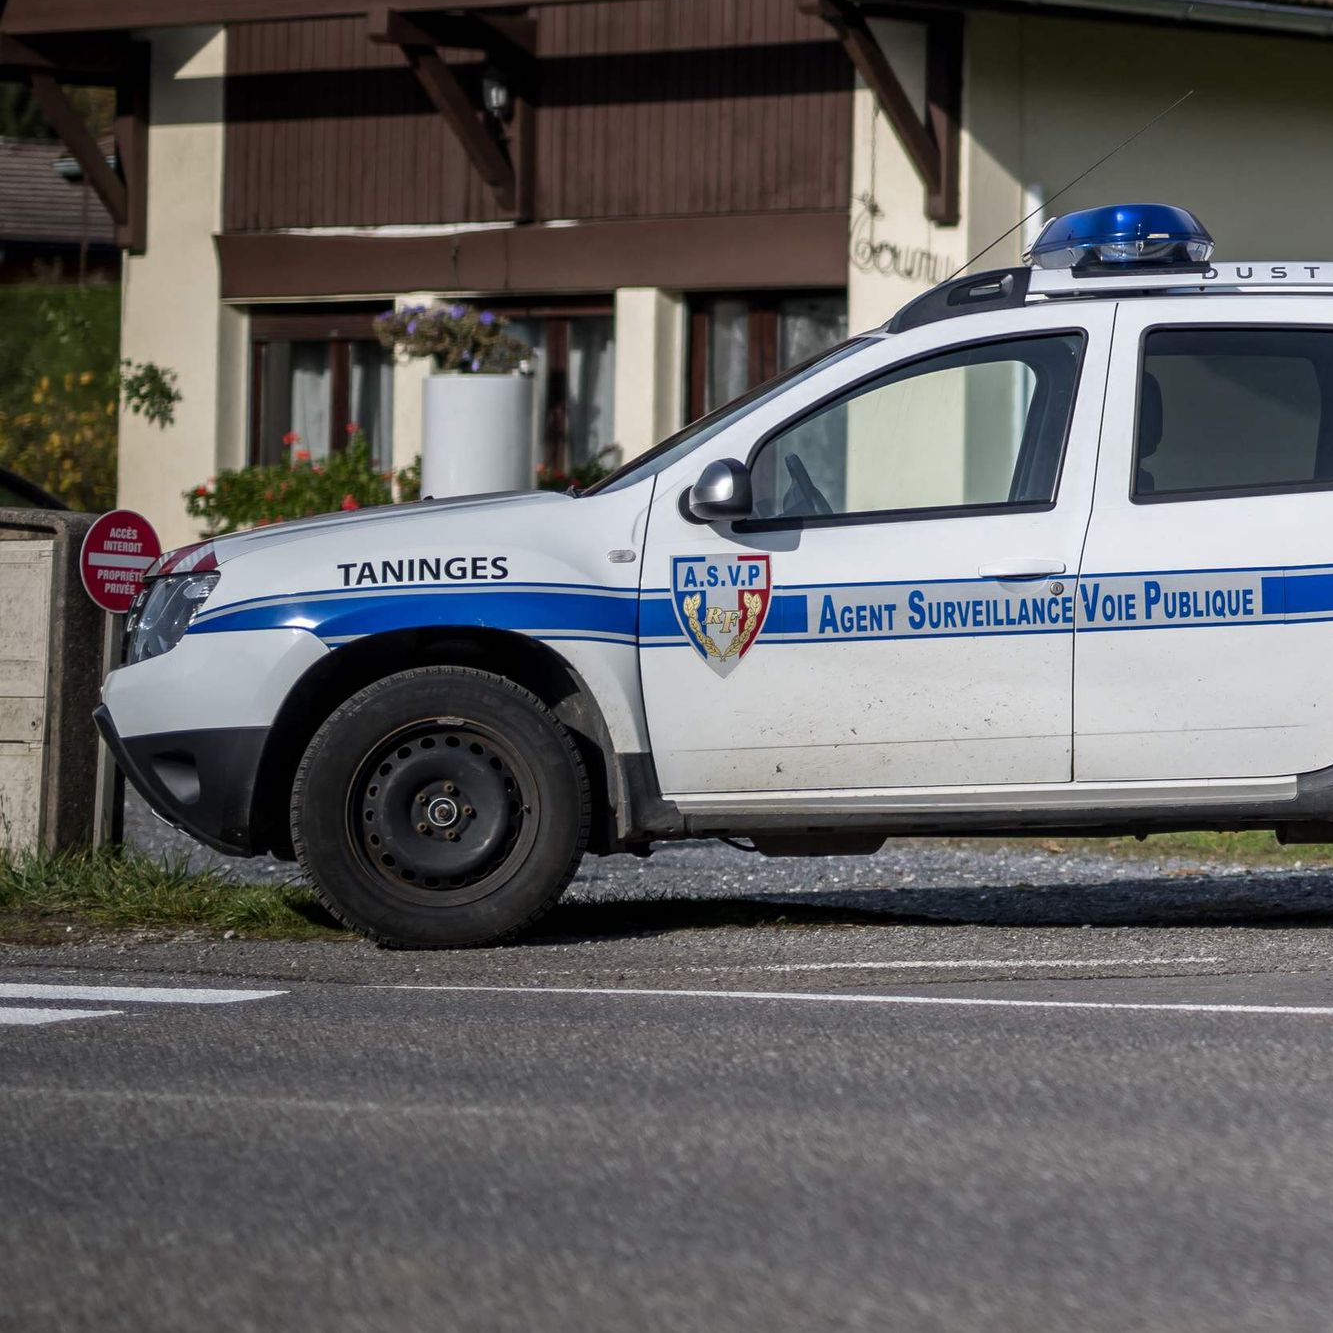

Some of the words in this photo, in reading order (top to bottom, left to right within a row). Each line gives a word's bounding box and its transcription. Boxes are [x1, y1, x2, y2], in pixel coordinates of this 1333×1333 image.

[109, 526, 138, 540] ACCÈS
[103, 540, 143, 553] INTERDIT
[337, 556, 509, 586] TANINGES
[683, 564, 760, 588] A.S.V.P
[104, 581, 136, 595] PRIVÉE
[819, 594, 897, 634] AGENT
[908, 589, 1073, 630] SURVEILLANCE
[1079, 582, 1137, 623] VOIE
[1144, 580, 1254, 620] PUBLIQUE
